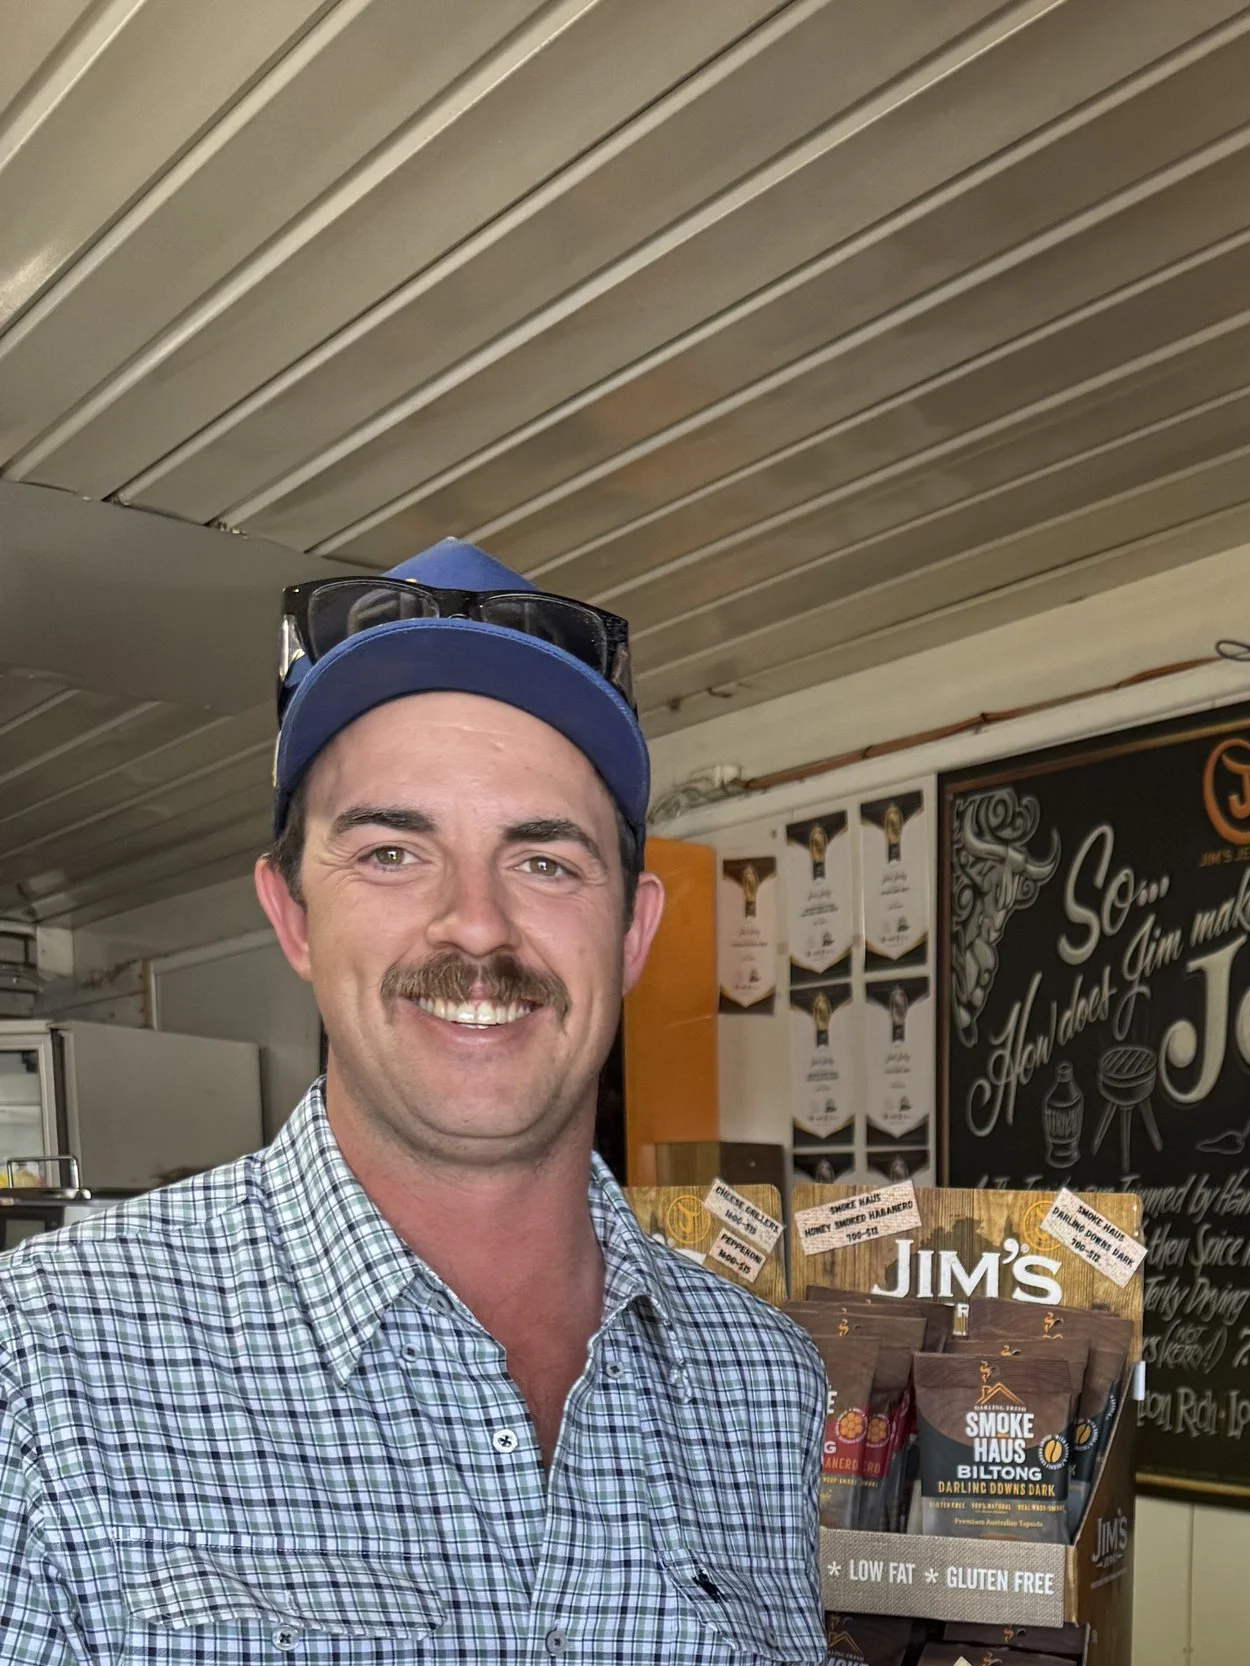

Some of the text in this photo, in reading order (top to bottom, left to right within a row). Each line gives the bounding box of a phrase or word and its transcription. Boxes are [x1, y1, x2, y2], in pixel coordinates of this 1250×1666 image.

[965, 971, 1058, 1136] How
[1058, 966, 1117, 1045] does
[715, 1186, 746, 1213] CHEESE
[830, 1193, 882, 1215] SMOKE HAUS
[804, 1201, 914, 1239] HONEY SMOKED HABANERO
[1052, 1206, 1135, 1269] DARLING DOWNS DARK
[1077, 1205, 1126, 1243] SMOKE HAUS
[721, 1233, 762, 1265] PEPPERONI
[872, 1237, 1062, 1305] JIM'S
[965, 1412, 1035, 1438] SMOKE
[1174, 1385, 1220, 1438] Rich
[973, 1438, 1026, 1464] HAUS
[938, 1481, 1056, 1498] DARLING DOWNS DARK
[957, 1465, 1042, 1481] BILTONG
[1091, 1508, 1128, 1563] JIM'S
[849, 1558, 1055, 1596] LOW FAT GLUTEN FREE
